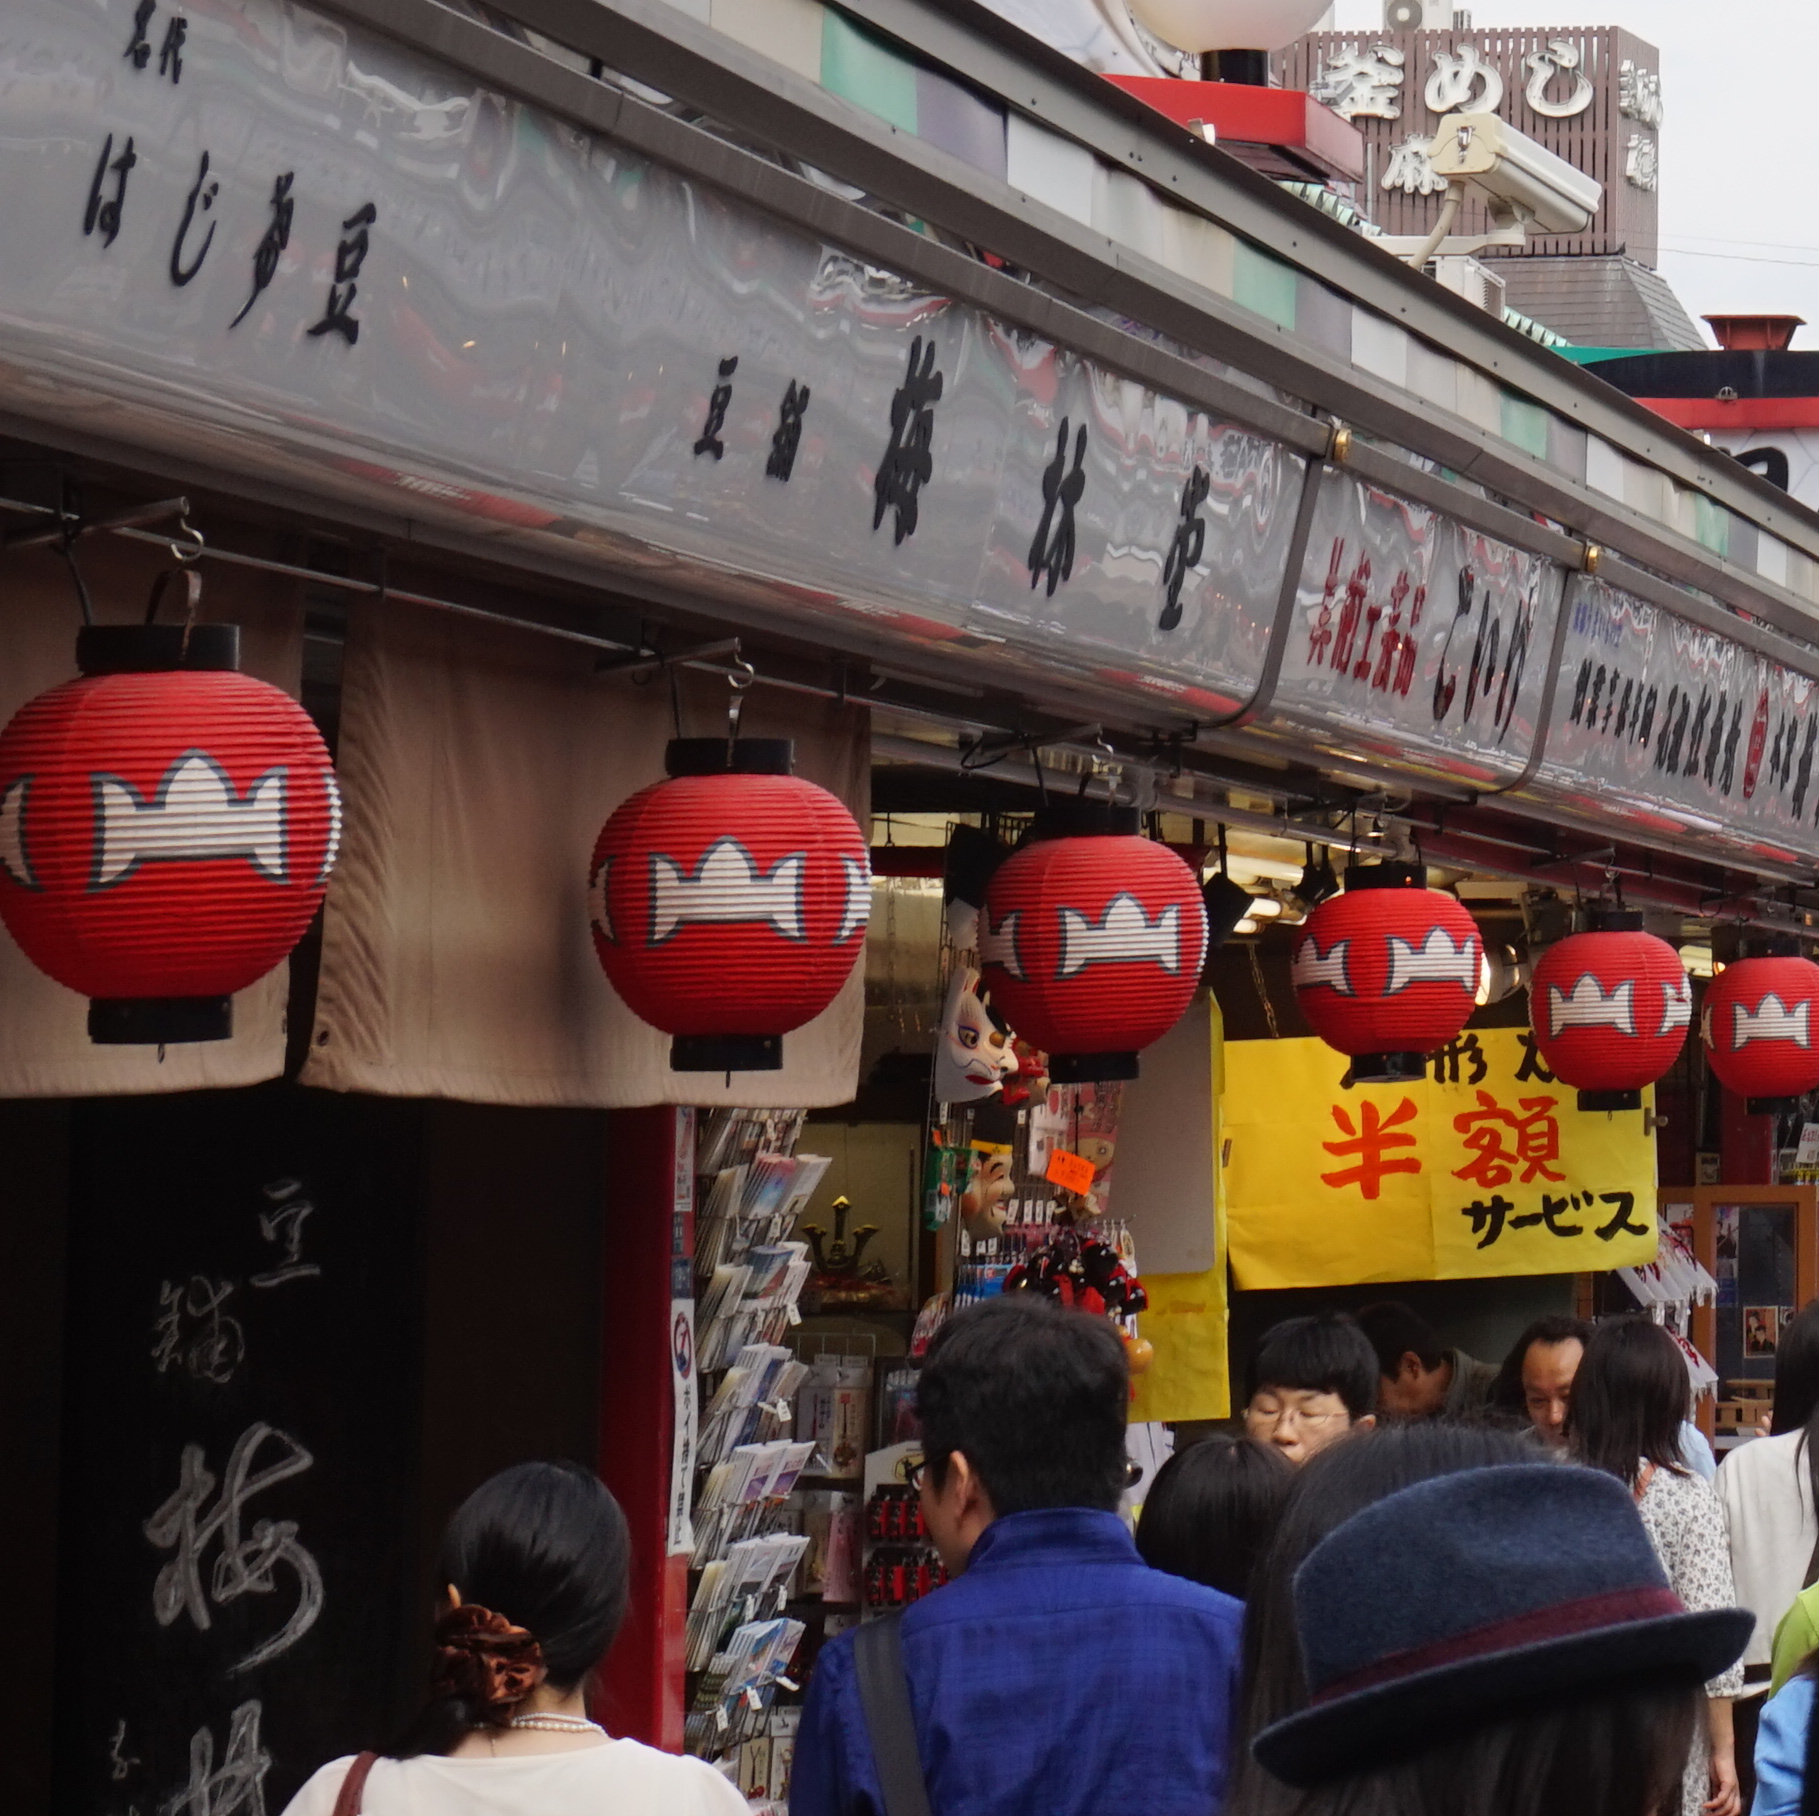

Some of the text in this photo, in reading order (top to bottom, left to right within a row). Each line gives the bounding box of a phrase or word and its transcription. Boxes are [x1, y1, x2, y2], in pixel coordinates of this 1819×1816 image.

[1319, 1088, 1567, 1201] 半額
[1461, 1188, 1651, 1250] サービス
